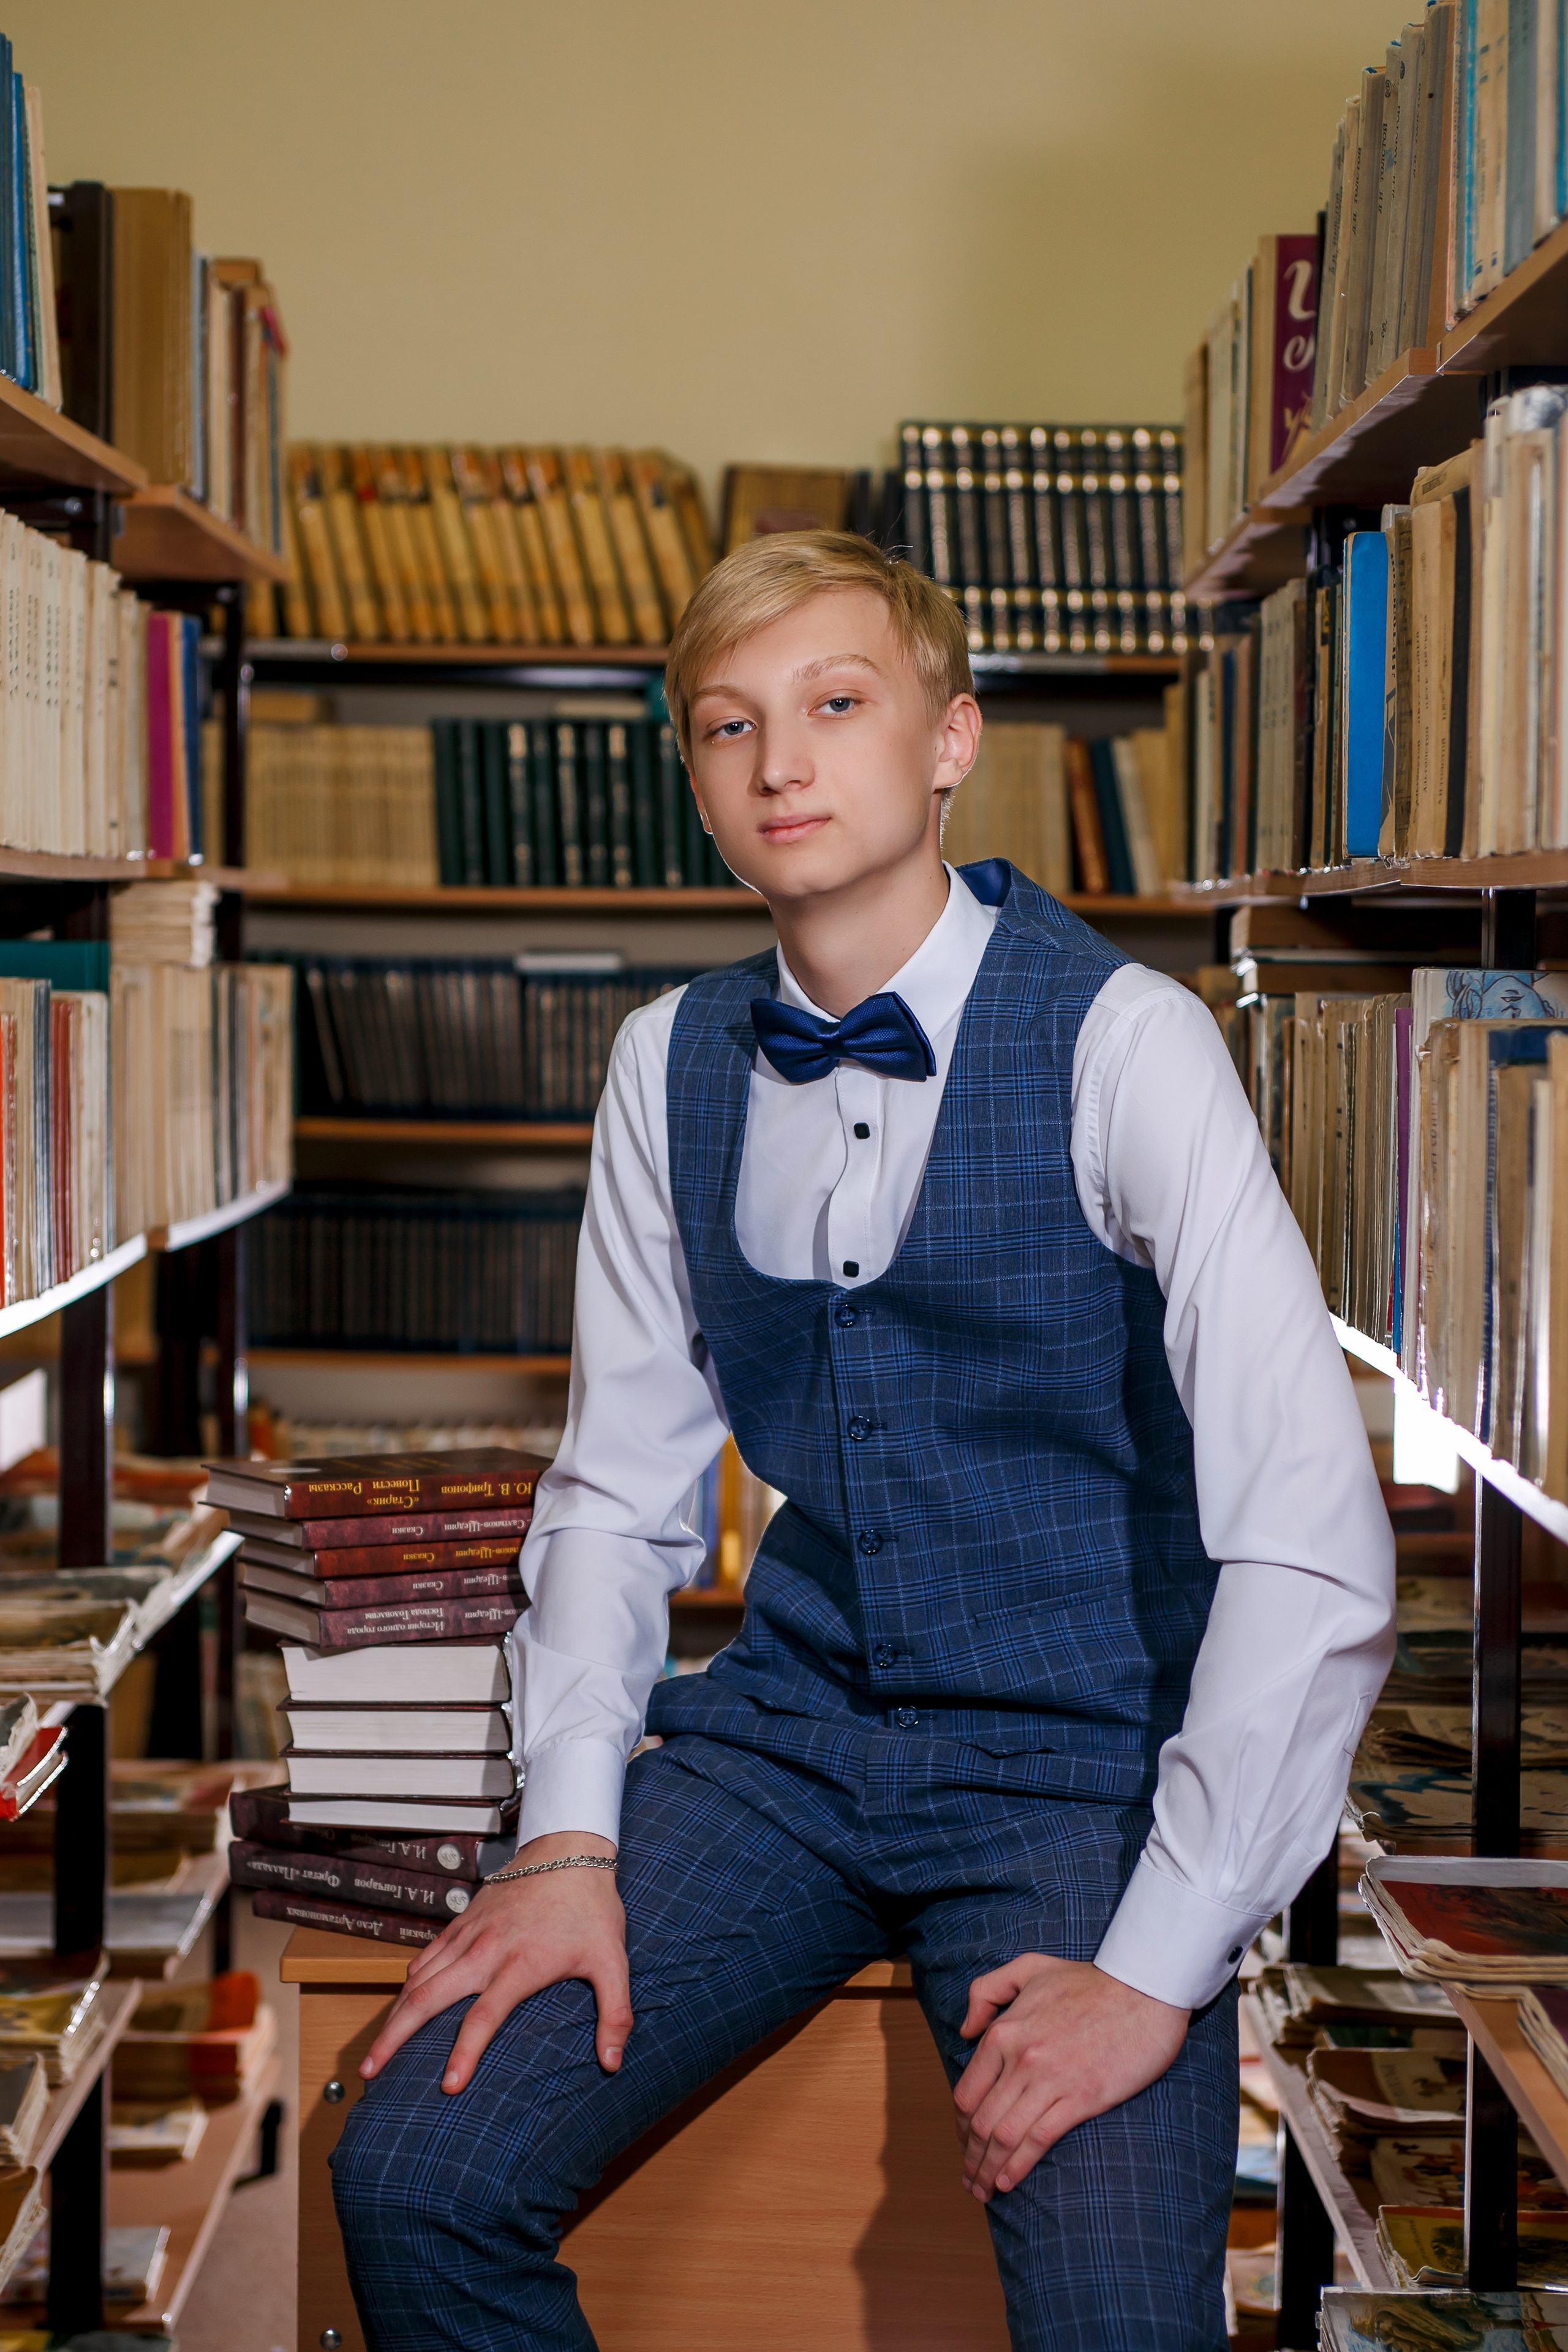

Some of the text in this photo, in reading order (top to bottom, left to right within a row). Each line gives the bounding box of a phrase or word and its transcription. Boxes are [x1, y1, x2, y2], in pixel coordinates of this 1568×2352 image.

[308, 1479, 419, 1494] Повести Рассказы
[366, 1482, 532, 1509] Ю. В. Трифонов «Старик»
[391, 1519, 524, 1536] Салтыков-Щедрин Сказки
[402, 1553, 434, 1562] Сказки
[412, 1581, 443, 1591] Сказки
[364, 1607, 443, 1620] Господа Головлевы
[347, 1624, 375, 1635] города
[377, 1623, 405, 1633] одного
[407, 1621, 443, 1631] История
[246, 1861, 434, 1904] И. А. Гончаров Фрегат «Паллада»
[286, 1907, 437, 1939] орький Дело Артамоновых
